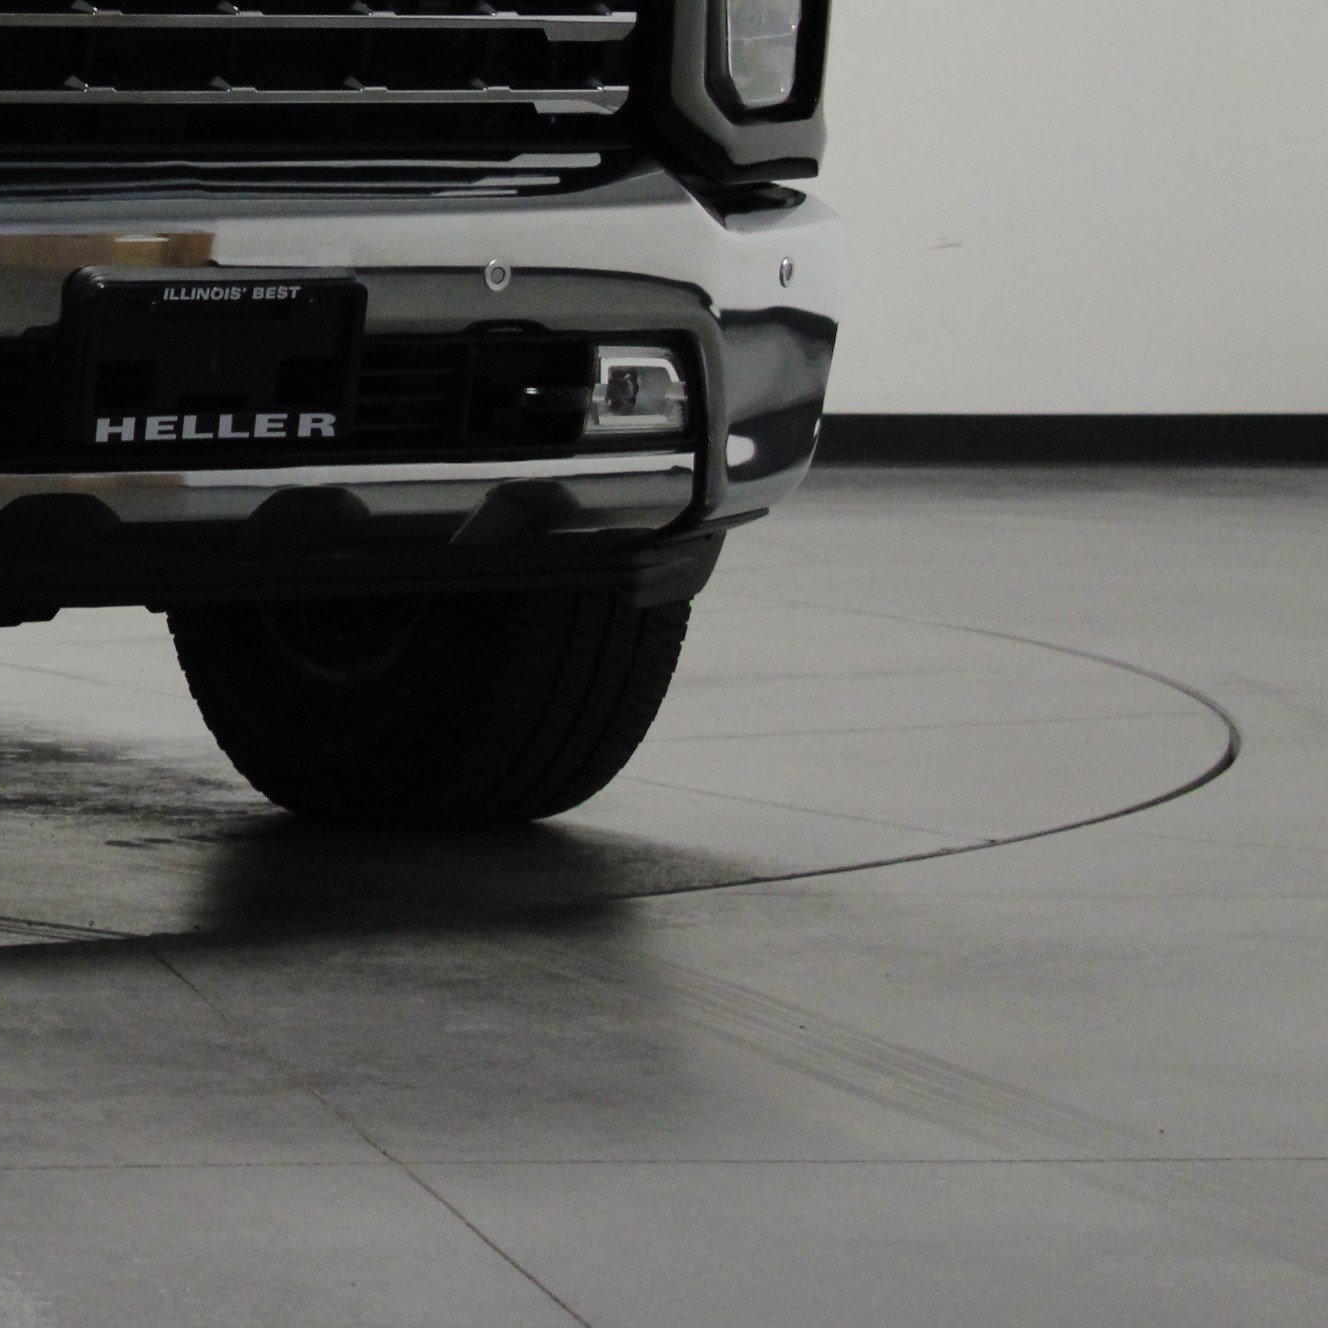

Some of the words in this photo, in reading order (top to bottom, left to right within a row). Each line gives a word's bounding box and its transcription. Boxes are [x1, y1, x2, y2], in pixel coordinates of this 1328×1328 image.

[162, 286, 248, 301] ILLINOIS'
[251, 285, 302, 300] BEST
[94, 412, 337, 443] HELLER
